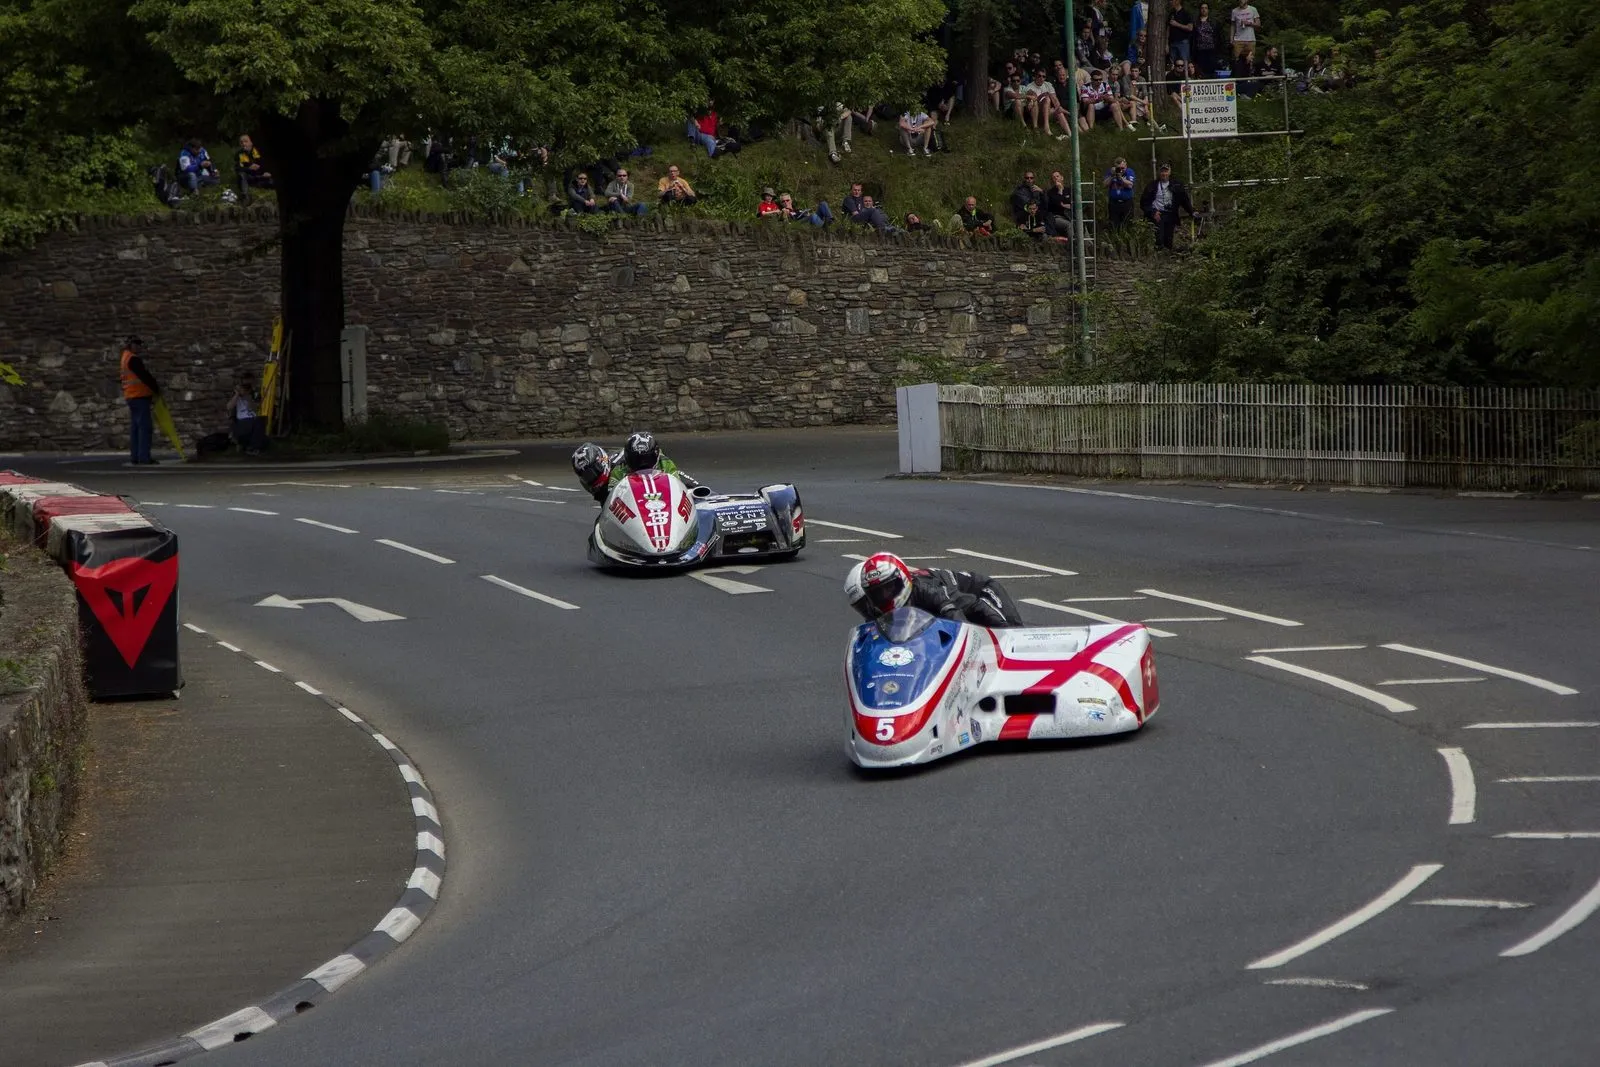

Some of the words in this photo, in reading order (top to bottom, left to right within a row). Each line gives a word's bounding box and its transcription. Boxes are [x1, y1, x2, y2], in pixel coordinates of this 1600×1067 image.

[1193, 84, 1224, 96] ABSOLUTE
[718, 512, 766, 522] SIGNS
[876, 718, 895, 741] 5
